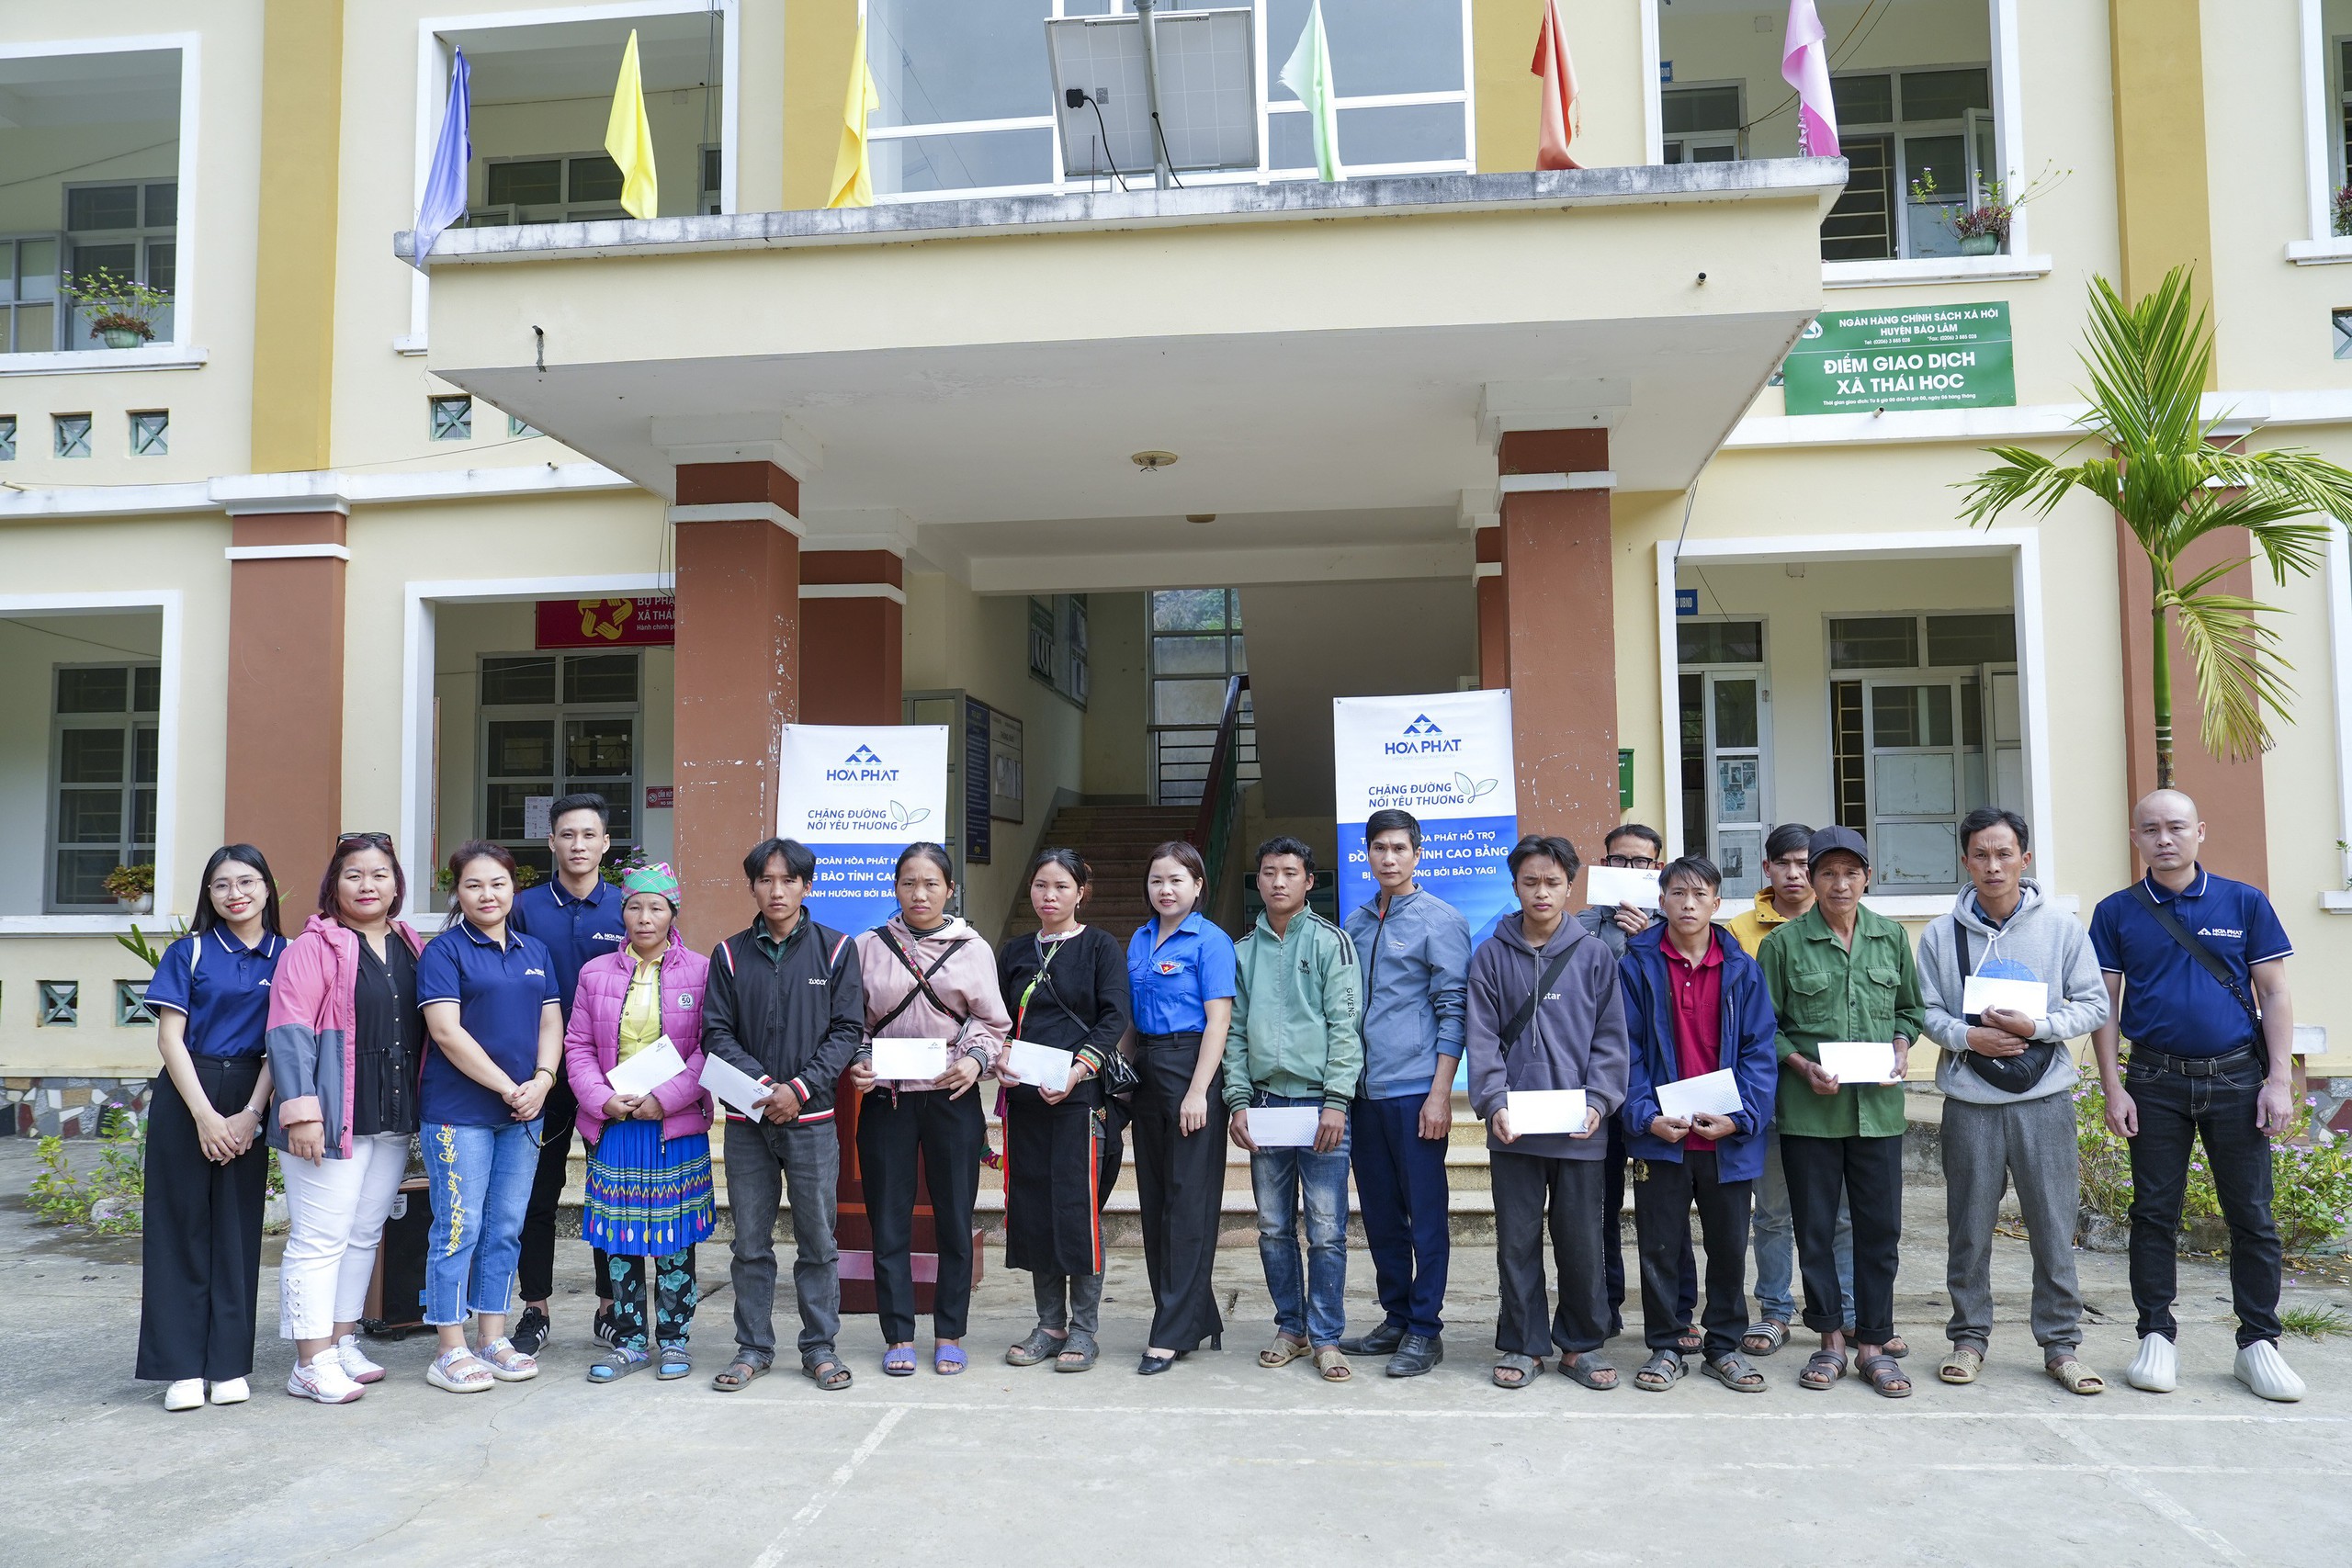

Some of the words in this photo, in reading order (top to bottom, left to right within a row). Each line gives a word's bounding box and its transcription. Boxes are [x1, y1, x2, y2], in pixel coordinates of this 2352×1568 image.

[1839, 317, 1868, 328] NGÂN
[1870, 314, 1899, 325] HÀNG
[1901, 311, 1932, 323] CHÍNH
[1934, 309, 1962, 321] SÁCH
[1964, 309, 1979, 320] XÃ
[1981, 307, 1999, 319] HỘI
[1880, 325, 1911, 337] HUYỆN
[1914, 324, 1935, 334] BẢO
[1937, 322, 1957, 333] LÂM
[1823, 353, 1868, 374] ĐIỂM
[1872, 355, 1923, 372] GIAO
[1928, 352, 1976, 370] DỊCH
[1836, 376, 1866, 395] XÃ
[1870, 373, 1914, 393] THÁI
[1919, 372, 1965, 392] HỌC
[638, 609, 651, 620] XÃ
[1385, 742, 1418, 755] HÒA
[1421, 739, 1461, 753] PHÁT
[826, 769, 858, 781] HÒA
[861, 769, 899, 781] PHÁT
[1368, 784, 1407, 797] CHẶNG
[1410, 781, 1451, 793] ĐƯỜNG
[1369, 796, 1389, 807] NỐI
[1392, 795, 1413, 807] YÊU
[1416, 795, 1464, 805] THƯƠNG
[808, 808, 845, 820] CHẶNG
[847, 808, 887, 818] ĐƯỜNG
[807, 819, 826, 830] NỐI
[830, 820, 849, 830] YÊU
[852, 821, 897, 830] THƯƠNG
[1434, 833, 1457, 842] PHÁT
[1460, 830, 1474, 841] HỖ
[1476, 831, 1496, 841] TRỢ
[1446, 848, 1472, 859] CAO
[1475, 844, 1509, 858] BẰNG
[816, 856, 842, 865] ĐOÀN
[845, 856, 864, 865] HÒA
[866, 856, 889, 865] PHÁT
[821, 871, 845, 881] BÀO
[848, 870, 873, 881] TỈNH
[1362, 871, 1371, 881] BỊ
[1434, 867, 1450, 877] BỞI
[1452, 866, 1473, 875] BÃO
[1475, 867, 1497, 875] YAGI
[828, 888, 861, 897] HƯỞNG
[864, 888, 879, 897] BỞI
[1346, 988, 1355, 1018] GIVENS
